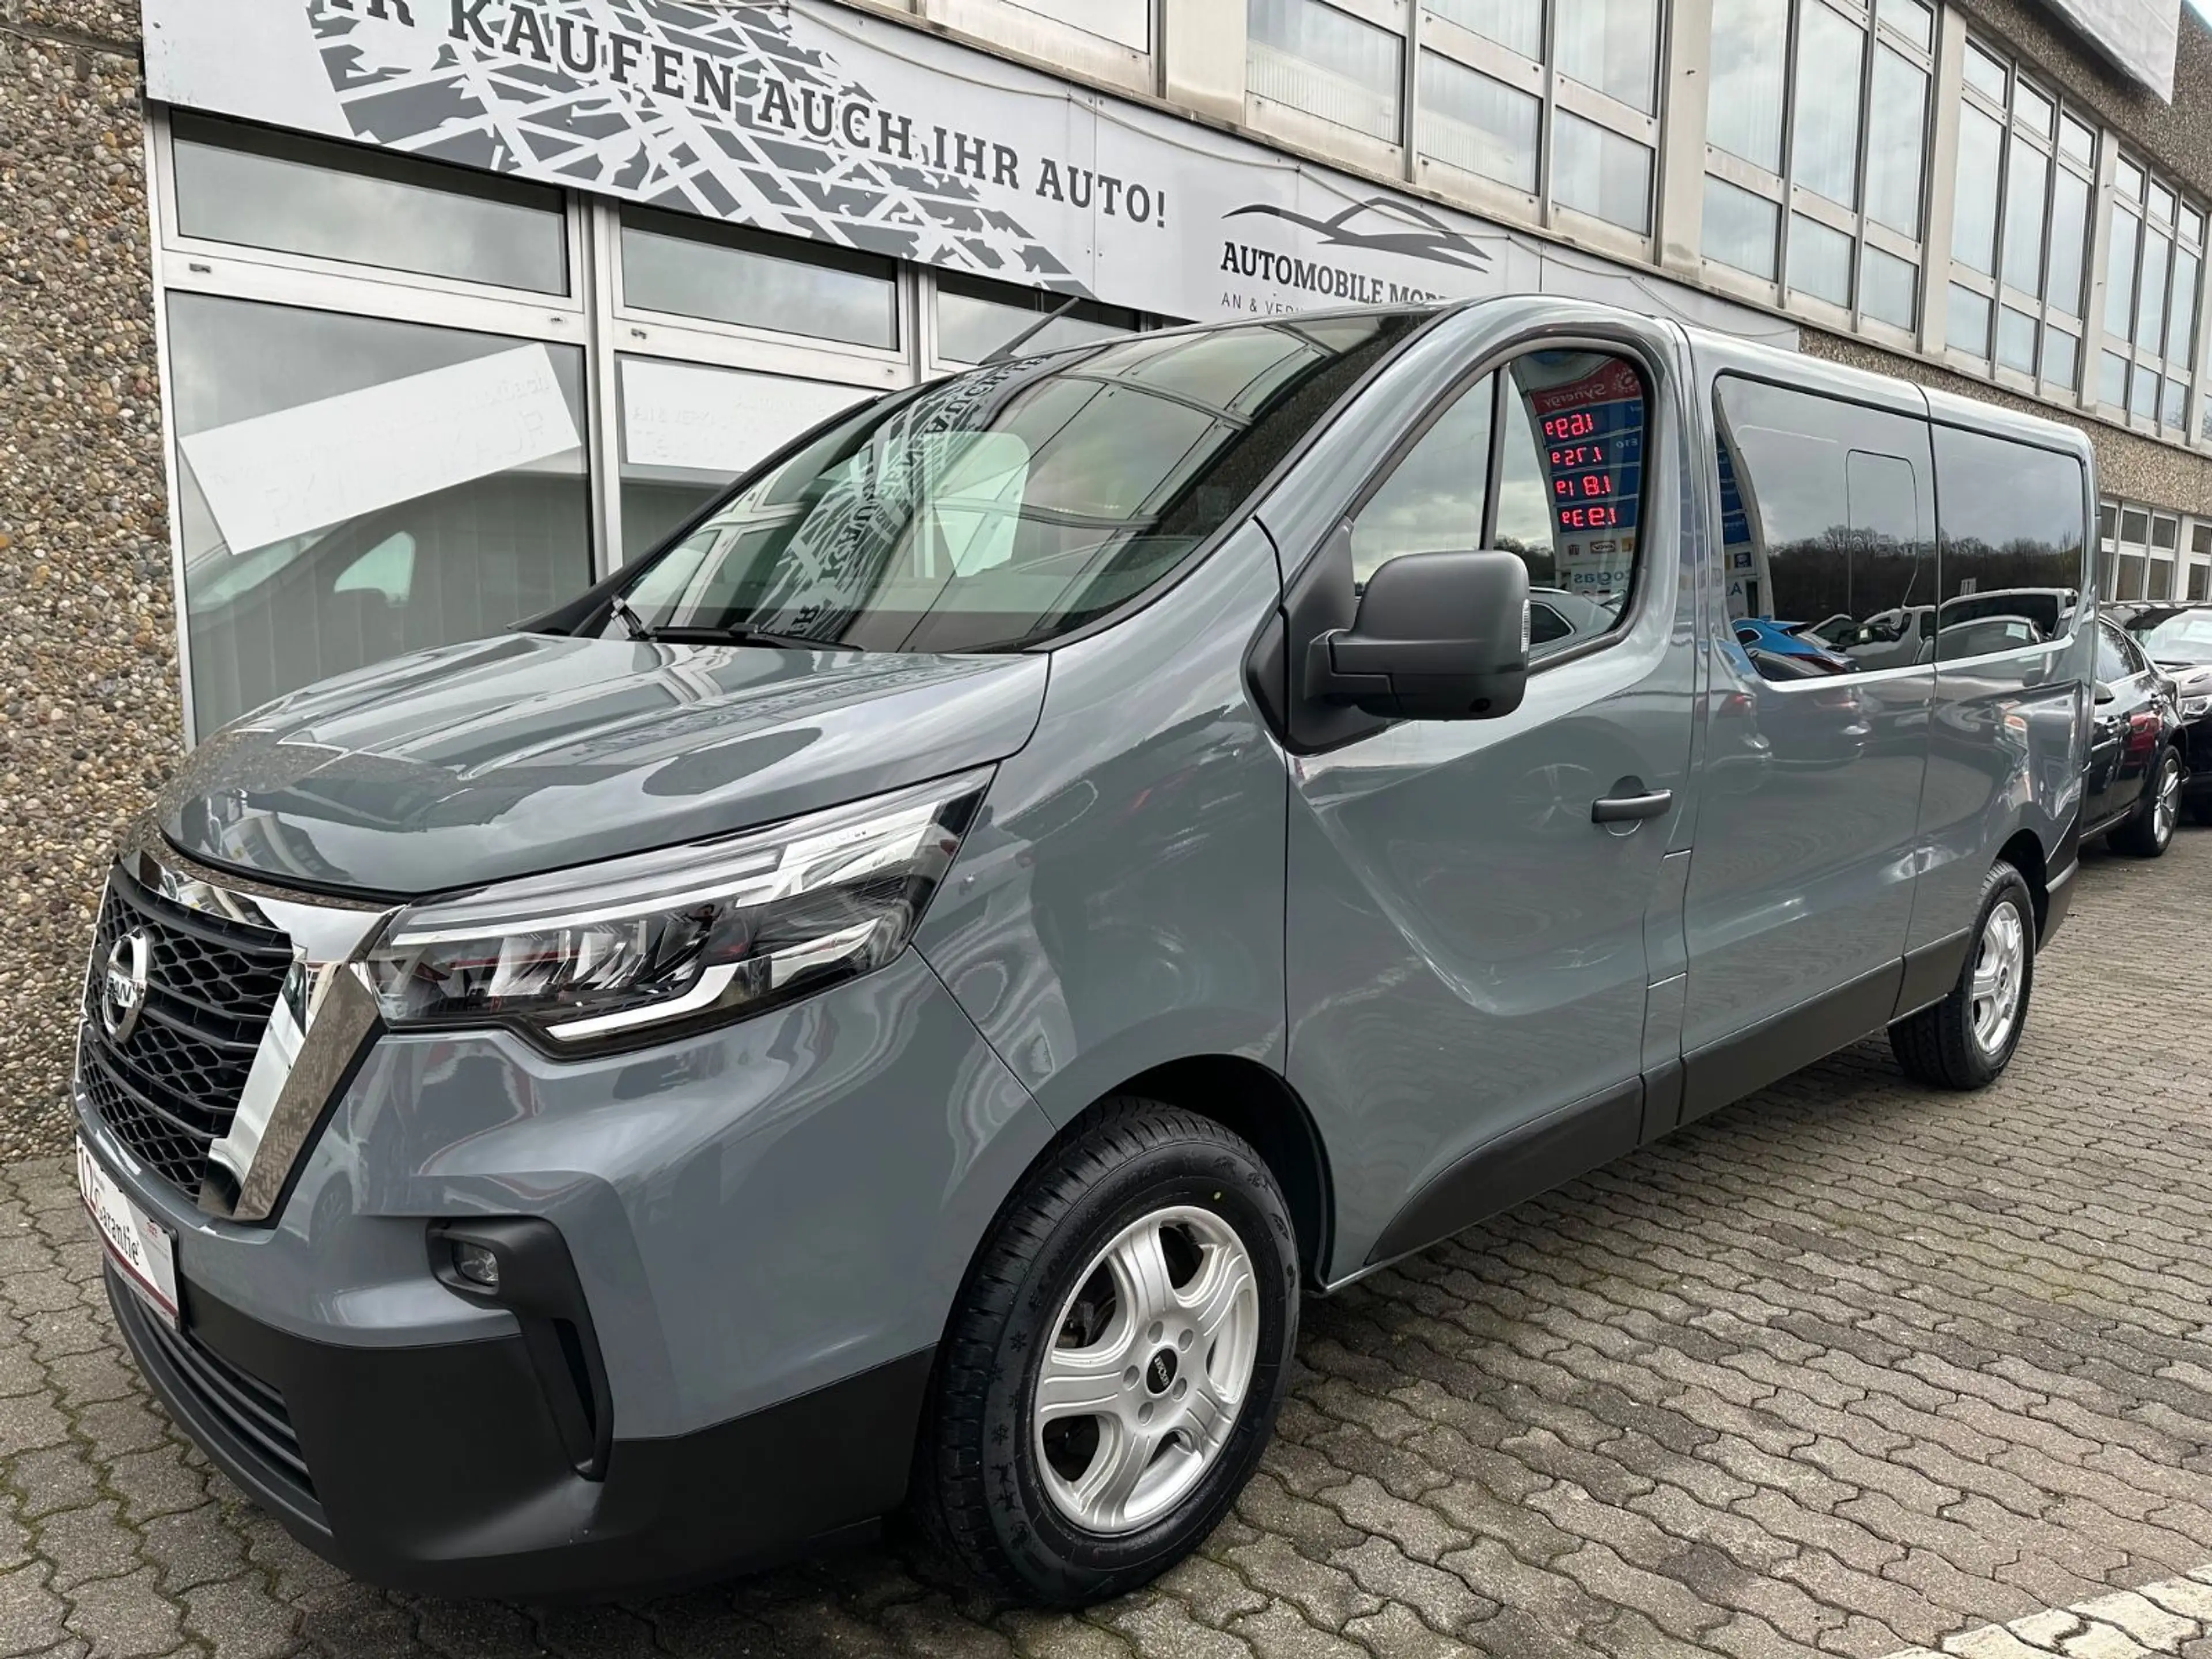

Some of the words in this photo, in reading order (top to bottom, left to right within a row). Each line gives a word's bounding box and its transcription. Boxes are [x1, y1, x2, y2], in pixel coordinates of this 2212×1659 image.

[449, 0, 734, 111] KAUFEN
[757, 77, 911, 160] AUCH
[933, 125, 1019, 189] IHR
[1036, 157, 1166, 227] AUTO!
[1221, 241, 1384, 304] AUTOMOBILE
[1221, 292, 1241, 309] AN
[1249, 298, 1257, 312] &
